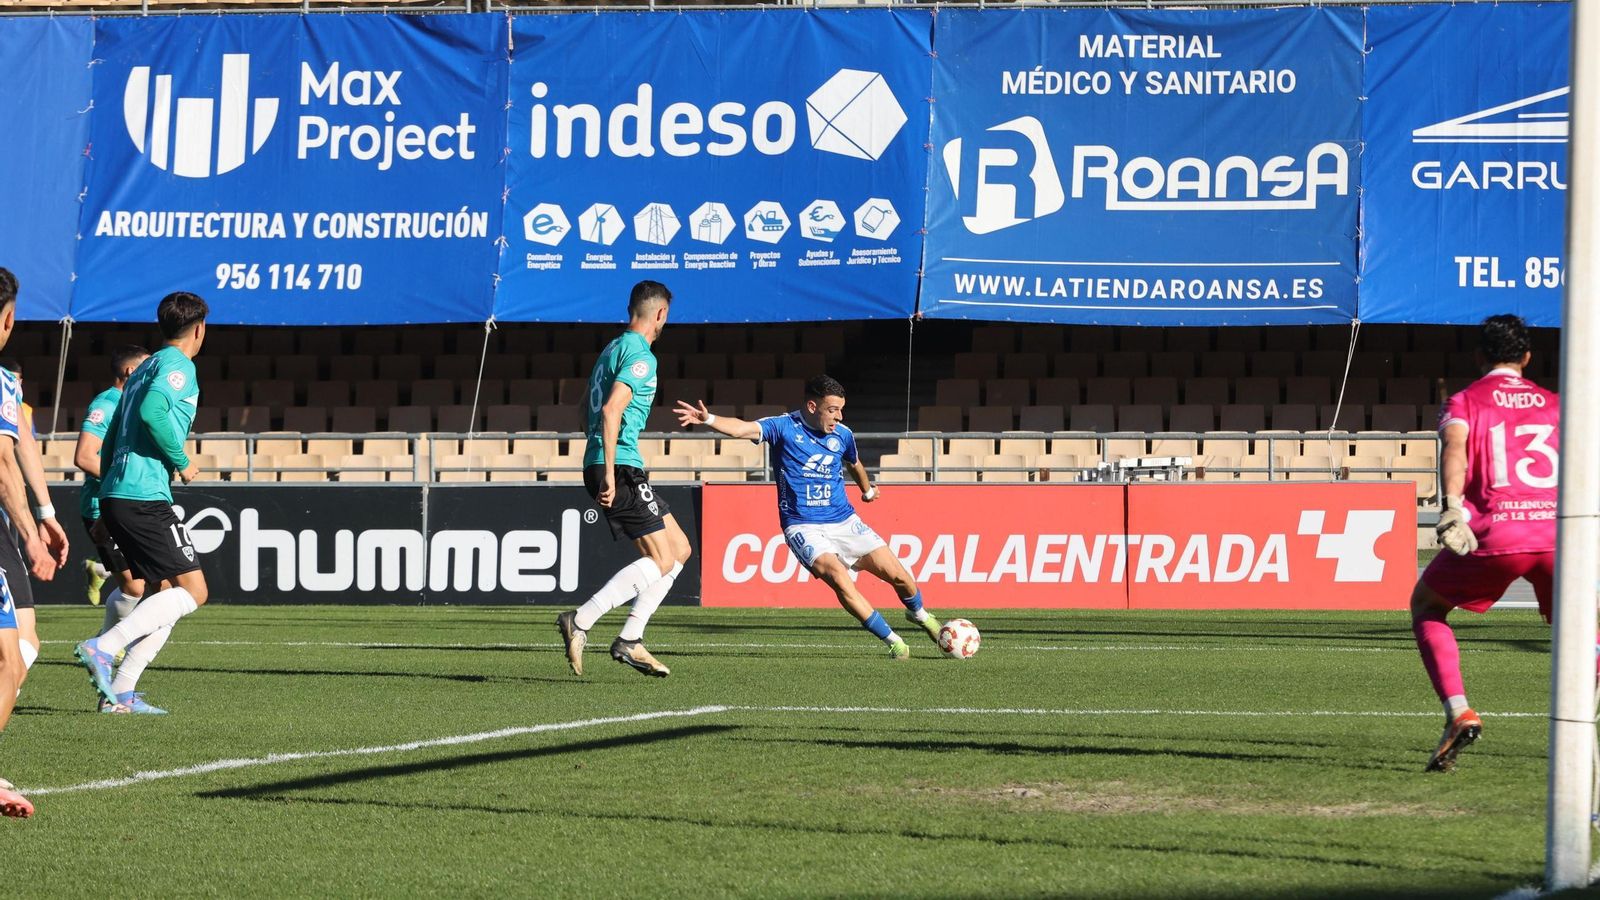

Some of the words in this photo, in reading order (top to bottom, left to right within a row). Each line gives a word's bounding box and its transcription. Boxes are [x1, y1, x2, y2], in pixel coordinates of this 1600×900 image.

[1080, 35, 1221, 58] MATERIAL
[300, 62, 403, 106] Max
[1002, 66, 1111, 94] MÉDICO
[1119, 71, 1137, 94] Y
[1146, 69, 1296, 94] SANITARIO
[531, 82, 796, 158] indeso
[298, 111, 475, 170] Project
[95, 211, 286, 238] ARQUITECTURA
[293, 213, 308, 238] Y
[313, 206, 488, 238] CONSTRUCIÓN
[216, 263, 260, 289] 956
[269, 264, 311, 289] 114
[318, 264, 362, 289] 710
[953, 273, 1324, 299] WWW.LATIENDAROANSA.ES
[1455, 257, 1515, 287] TEL.
[1525, 257, 1565, 288] 85
[1489, 421, 1559, 489] 13
[639, 483, 653, 502] 8
[239, 508, 581, 592] hummel
